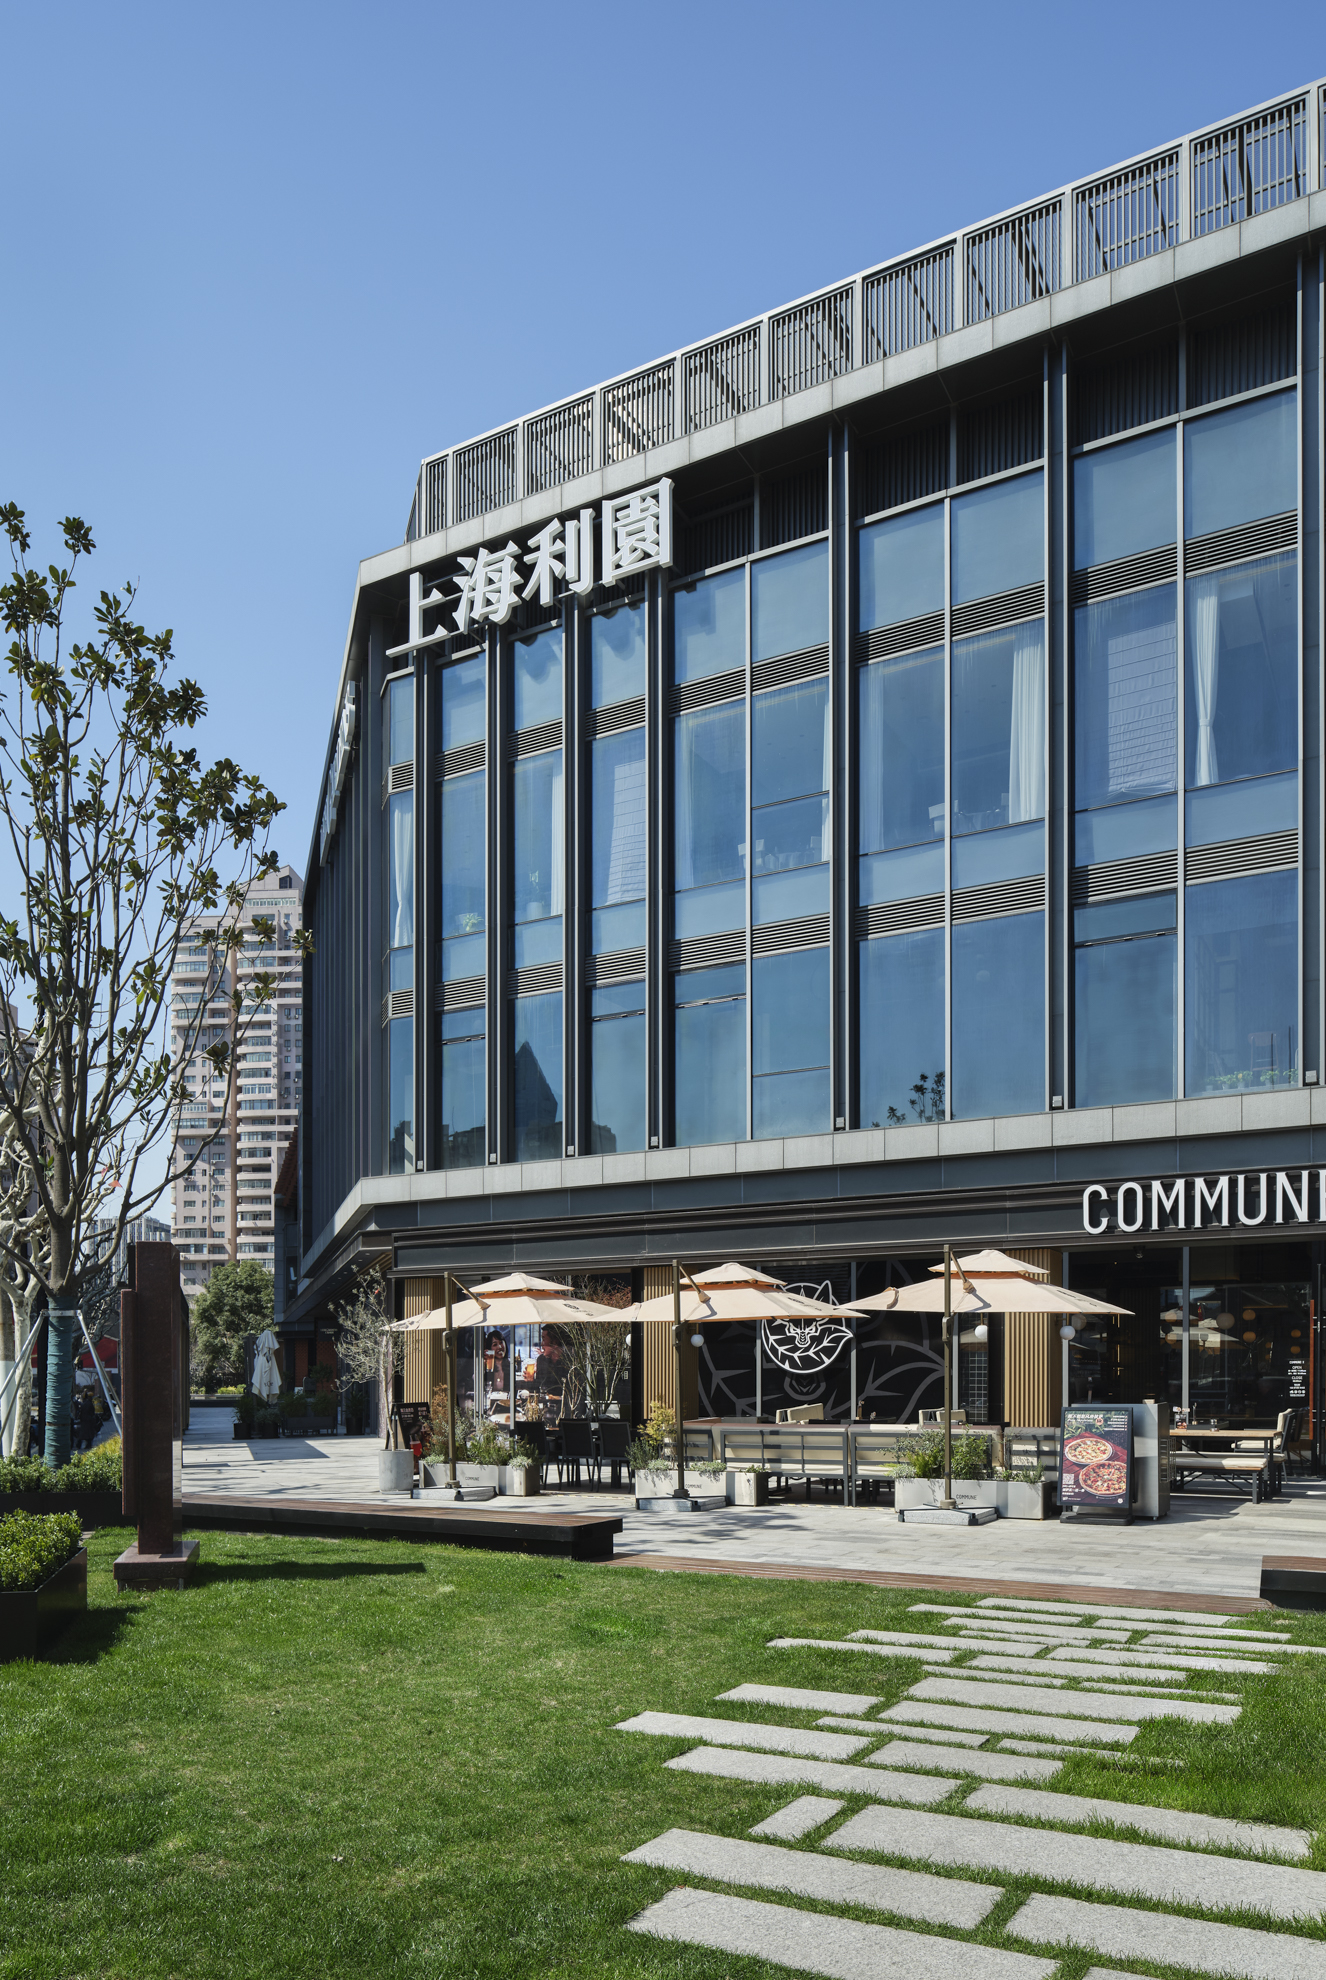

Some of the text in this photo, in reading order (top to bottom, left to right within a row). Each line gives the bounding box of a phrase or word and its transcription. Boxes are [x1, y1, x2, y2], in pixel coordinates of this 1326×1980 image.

[386, 477, 675, 658] 上海利園
[955, 1493, 978, 1501] COMMUNE
